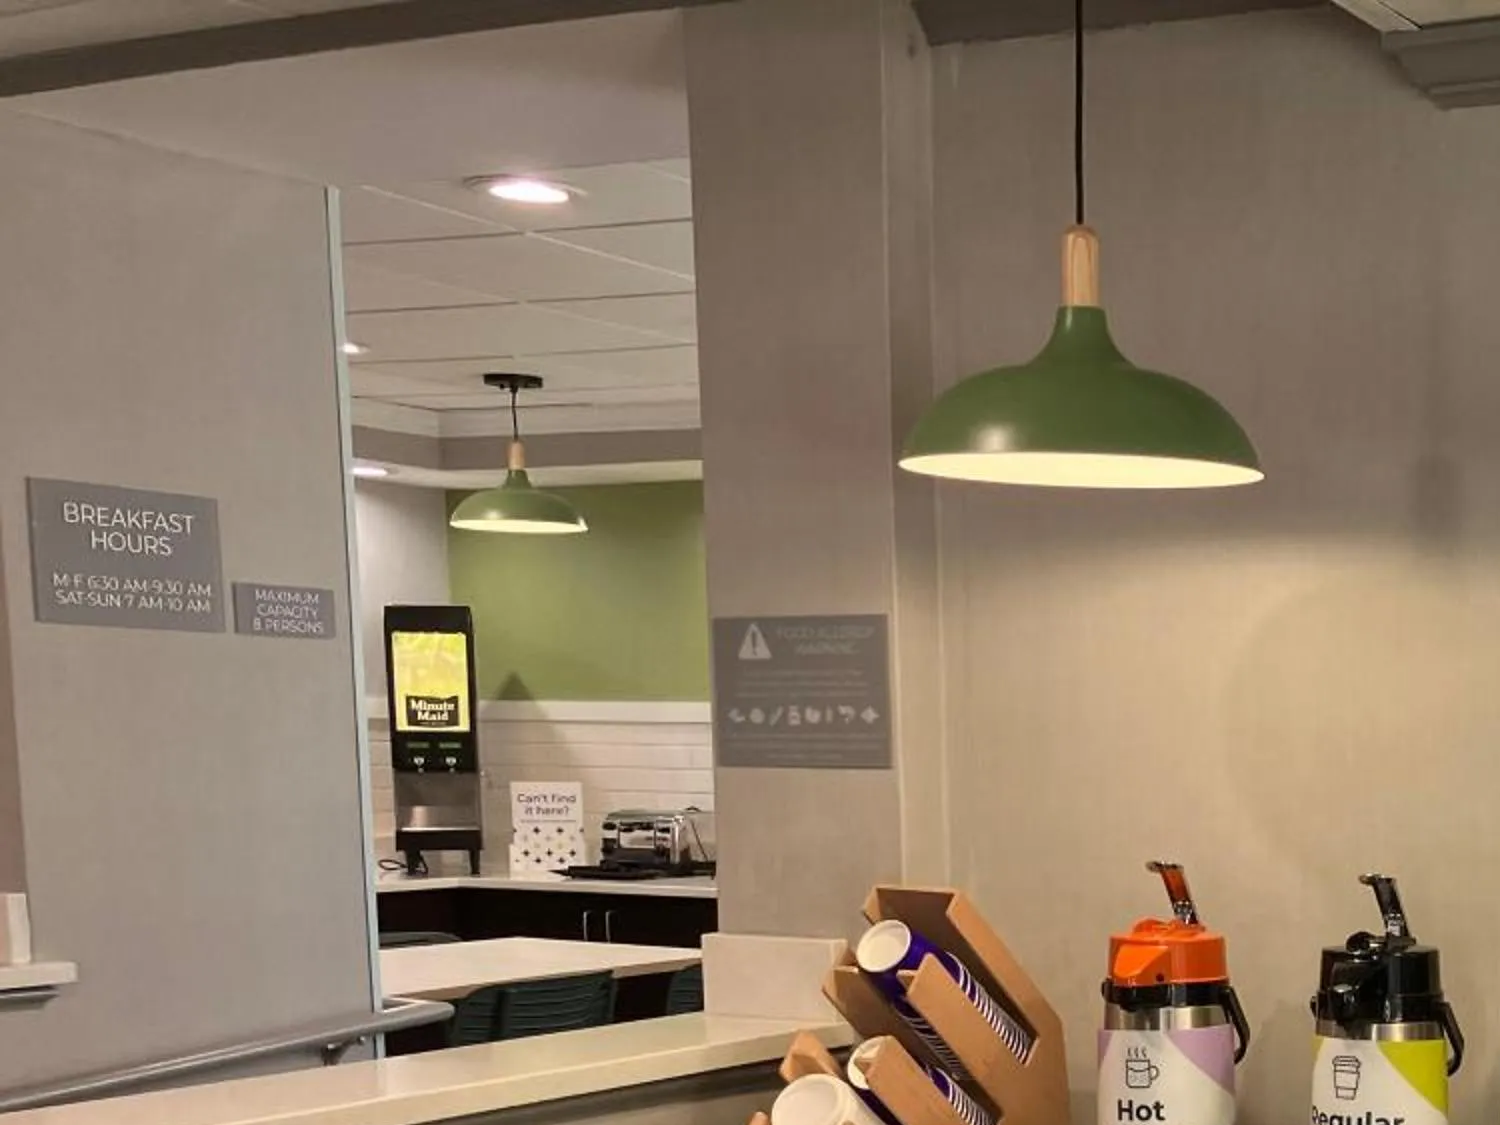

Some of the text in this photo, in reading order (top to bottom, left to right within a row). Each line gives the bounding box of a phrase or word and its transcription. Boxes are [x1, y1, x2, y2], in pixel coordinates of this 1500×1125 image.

[63, 501, 194, 535] BREAKFAST
[91, 529, 172, 556] HOURS
[187, 581, 212, 597] AM
[255, 588, 319, 605] MAXIMUM
[186, 598, 212, 613] AM
[257, 602, 319, 619] CAPACITY
[265, 617, 324, 635] PERSONS
[411, 698, 455, 711] Minute
[417, 710, 449, 721] Maid
[1117, 1098, 1166, 1121] Hot
